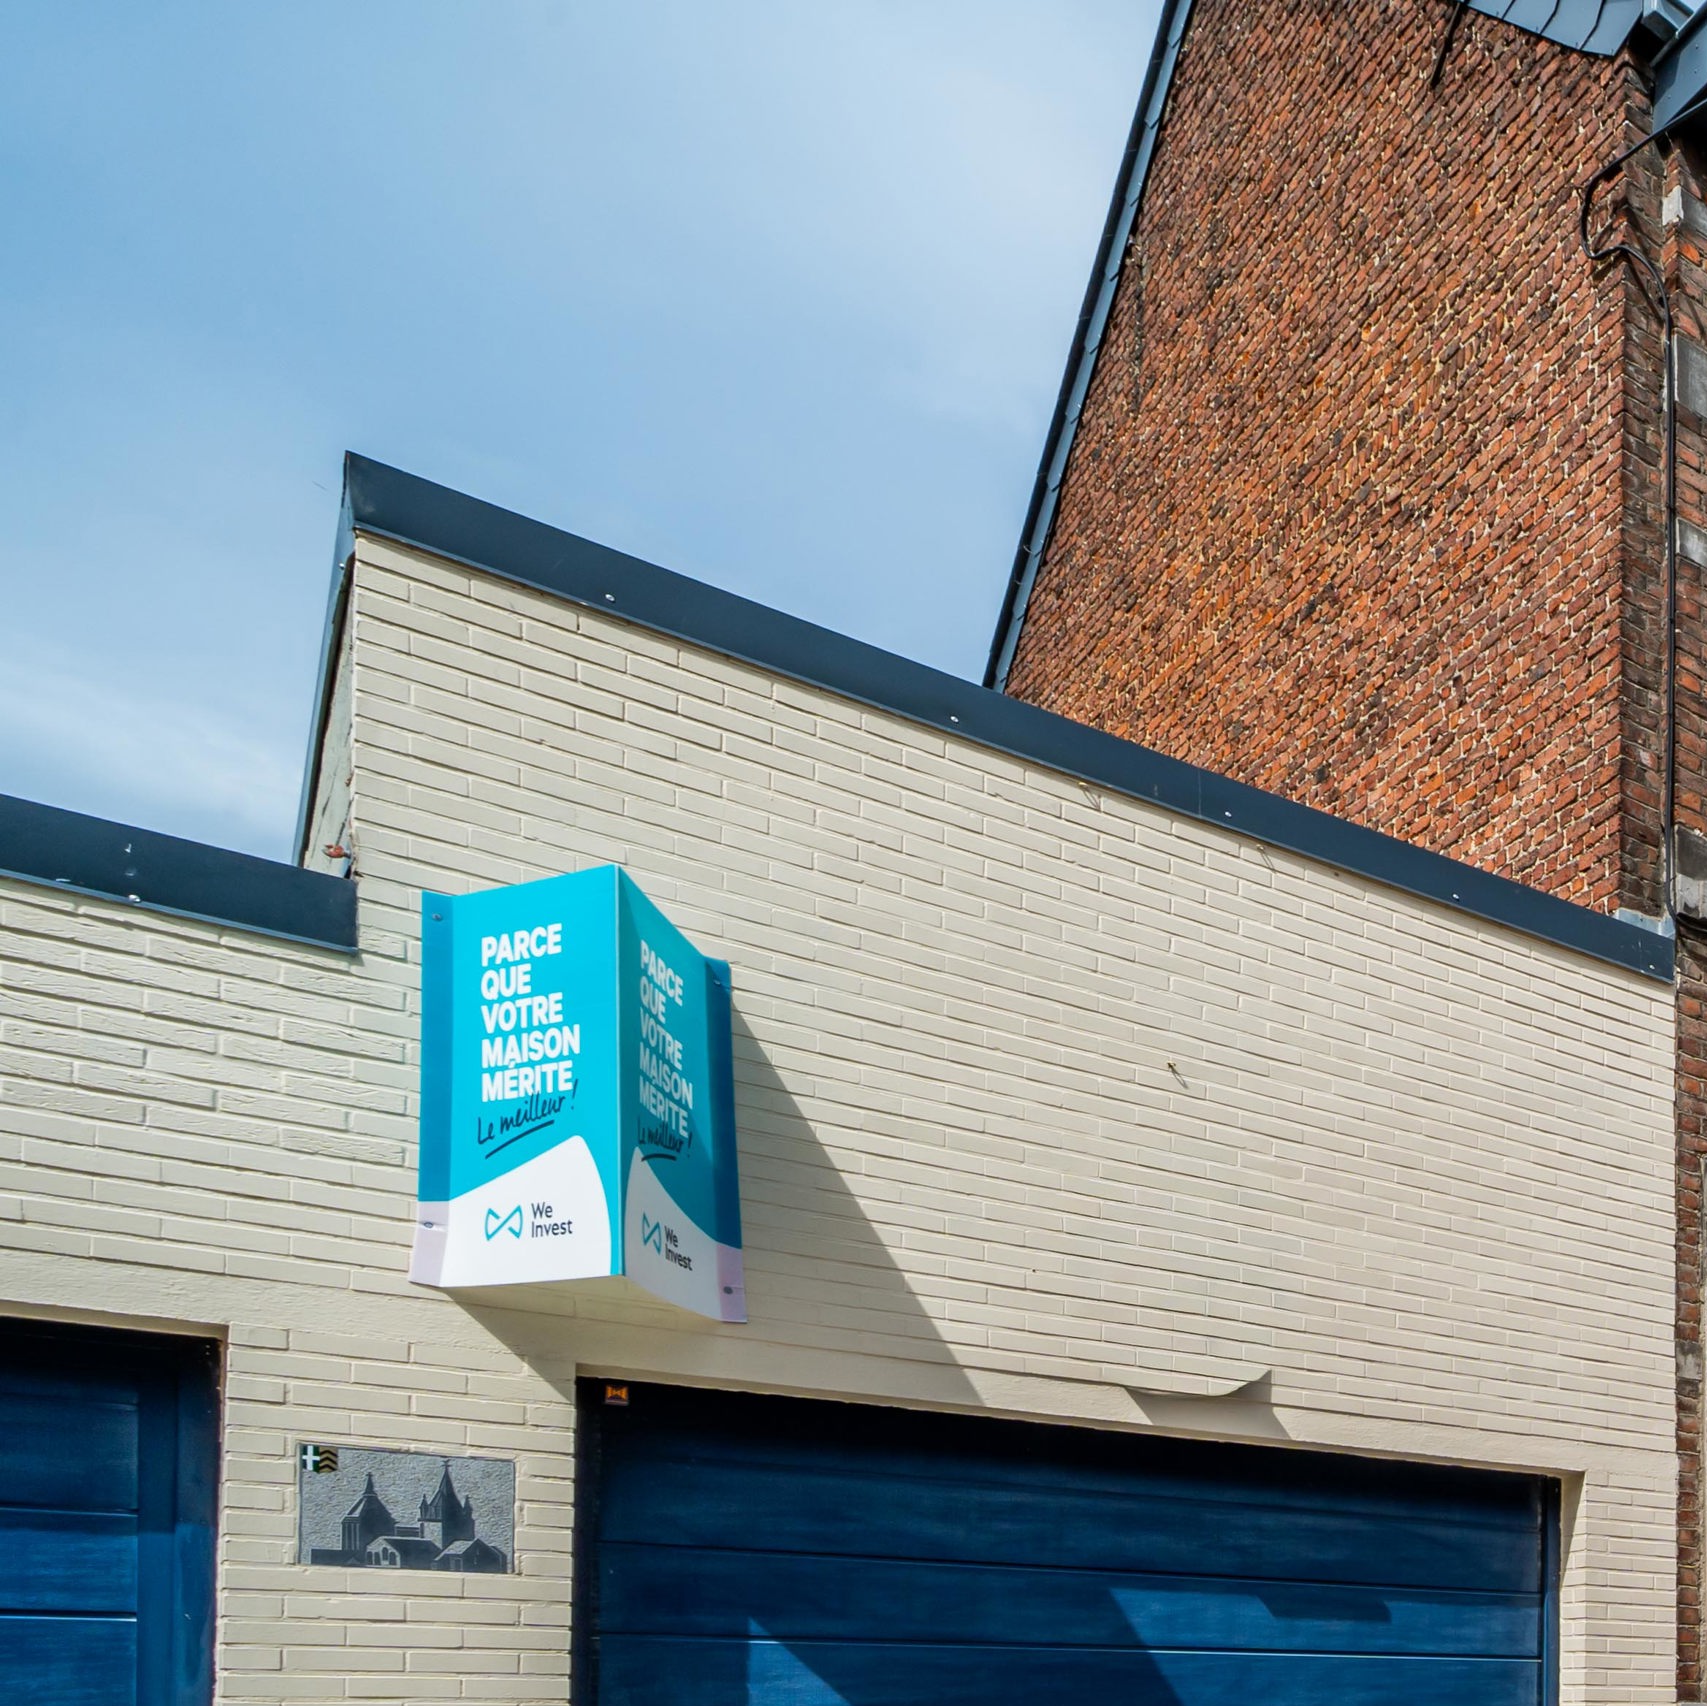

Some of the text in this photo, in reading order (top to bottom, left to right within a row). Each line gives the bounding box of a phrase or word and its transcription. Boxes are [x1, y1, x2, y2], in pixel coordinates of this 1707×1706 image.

[481, 923, 562, 967] PARCE
[480, 963, 532, 1001] QUE
[640, 939, 684, 1007] PARCE
[480, 992, 563, 1034] VOTRE
[640, 975, 666, 1025] QUE
[481, 1023, 580, 1069] MAISON
[640, 1006, 682, 1071] VOTRE
[481, 1059, 573, 1102] MÉRITE
[640, 1041, 693, 1110] MAISON
[477, 1116, 495, 1145] Le
[500, 1090, 566, 1134] meilleur
[531, 1201, 553, 1219] We
[531, 1219, 573, 1238] Invest
[664, 1225, 679, 1248] We
[665, 1243, 693, 1271] Invest
